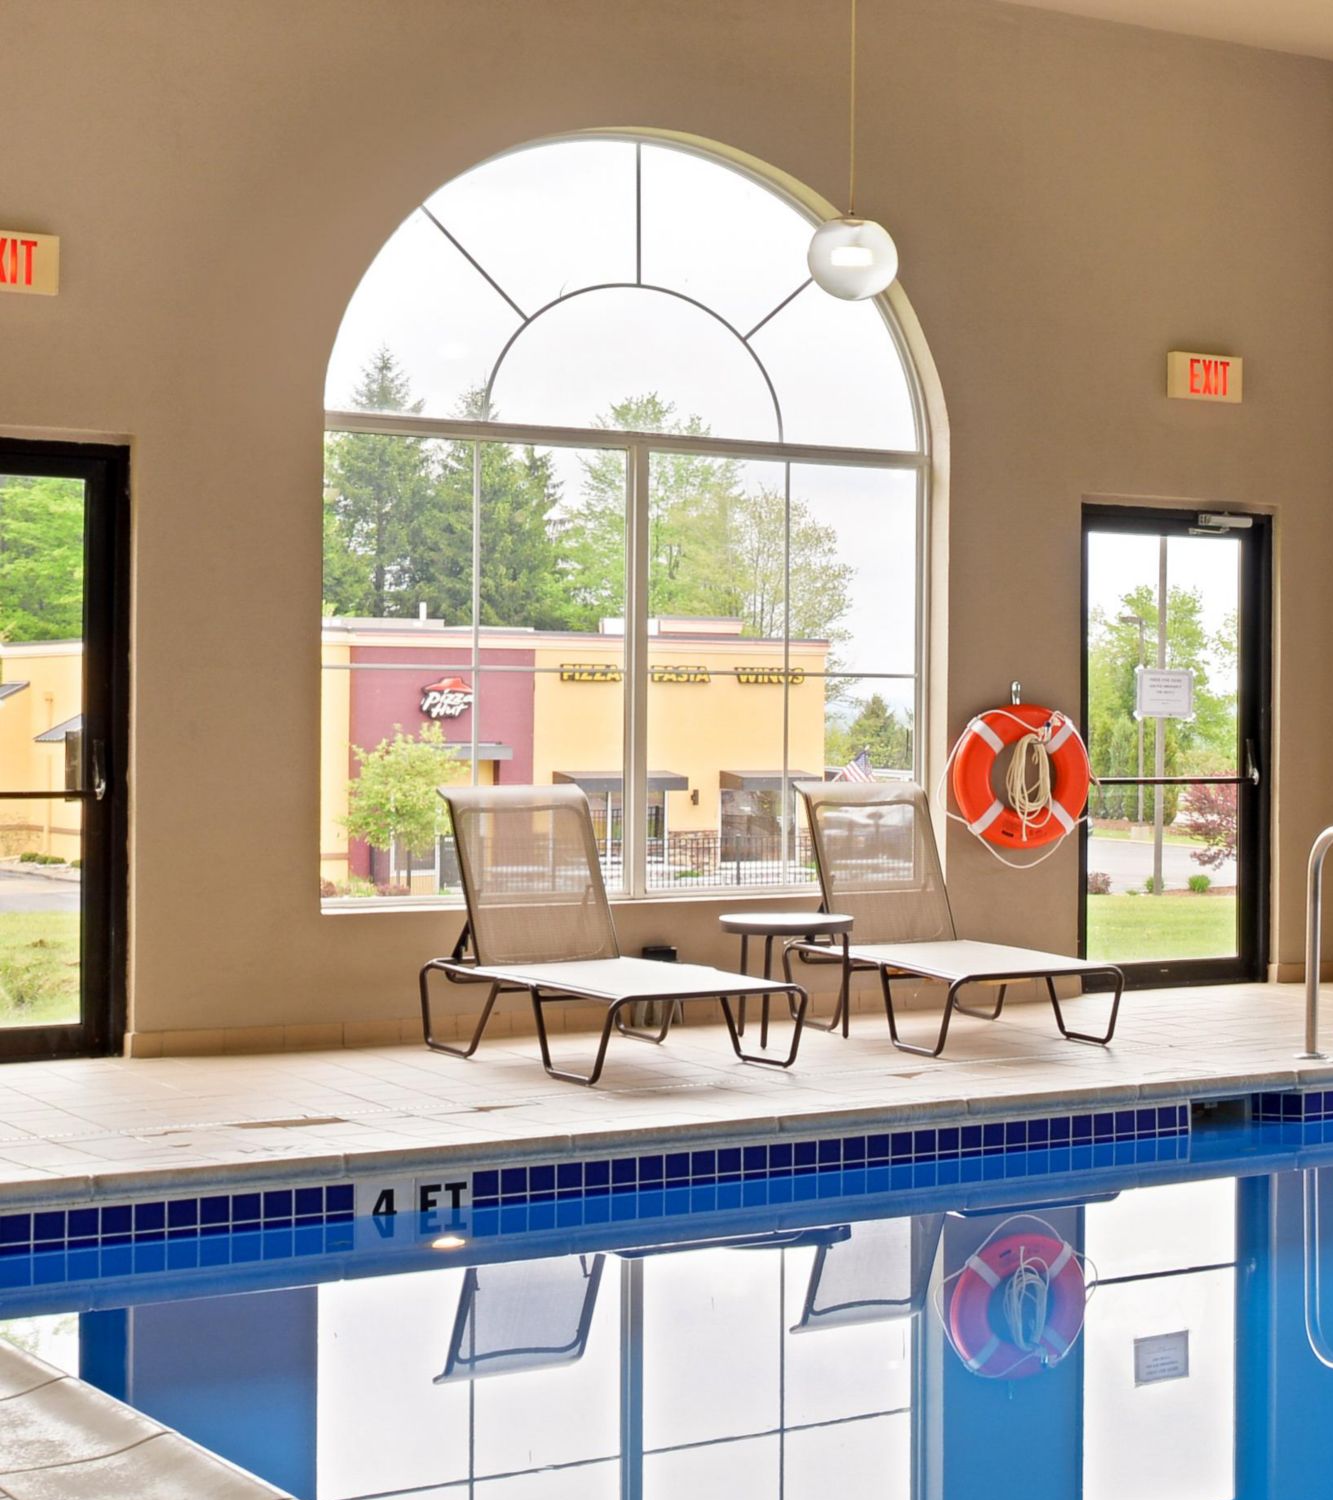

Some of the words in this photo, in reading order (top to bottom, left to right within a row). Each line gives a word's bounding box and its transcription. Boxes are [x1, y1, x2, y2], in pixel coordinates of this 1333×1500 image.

[1190, 358, 1230, 396] EXIT
[651, 665, 711, 684] PASTA
[431, 703, 468, 718] Hut
[372, 1188, 397, 1216] 4
[420, 1182, 467, 1212] FT
